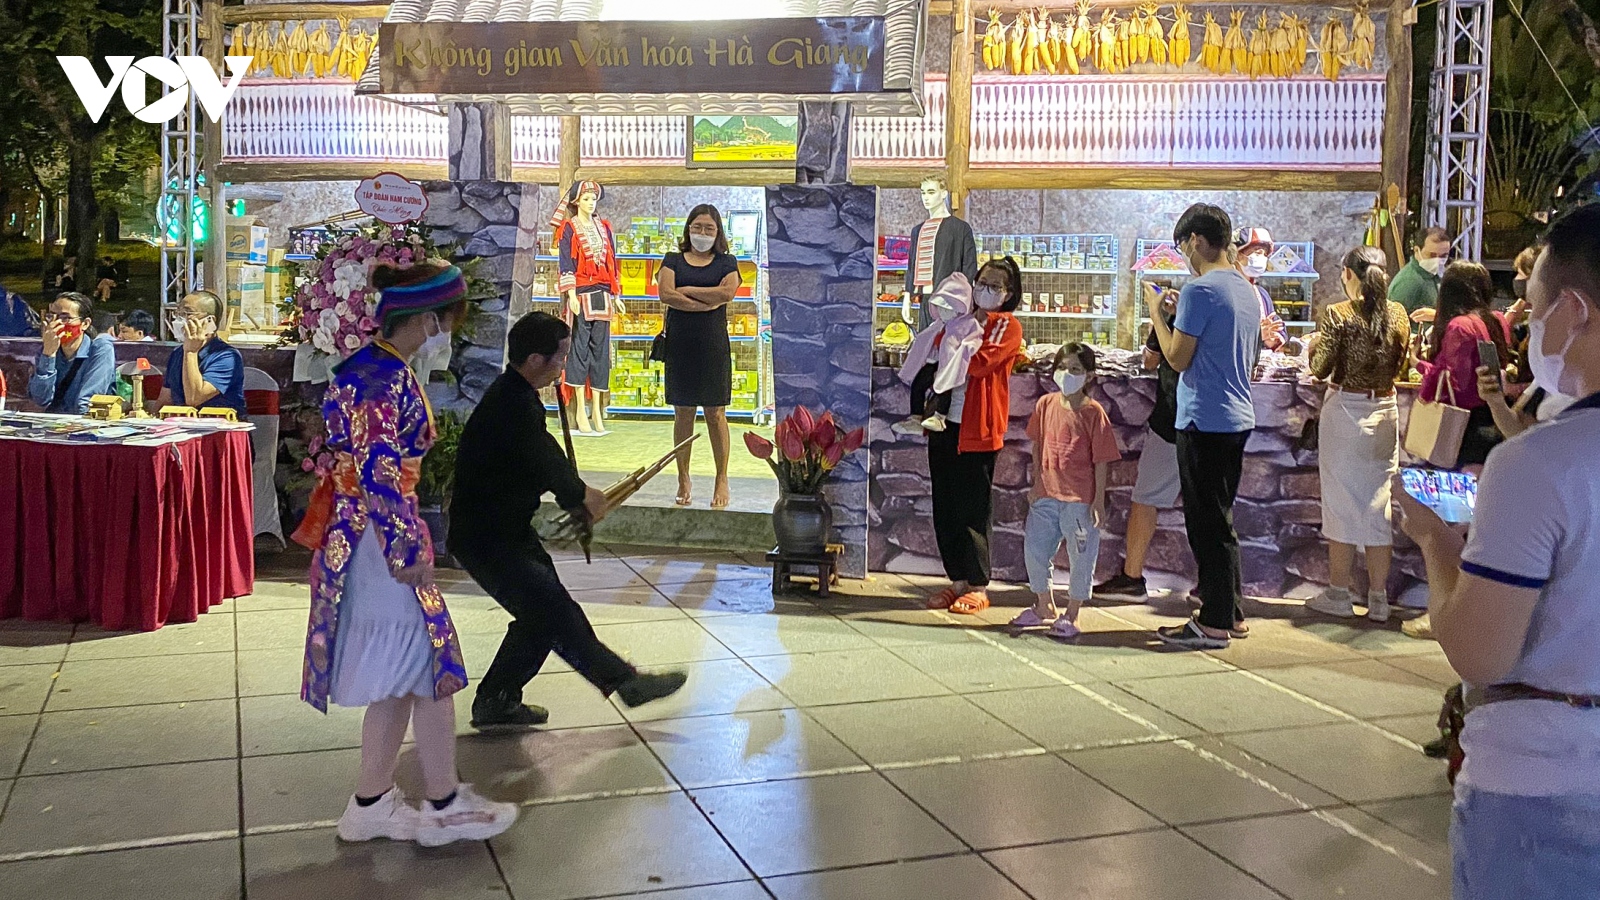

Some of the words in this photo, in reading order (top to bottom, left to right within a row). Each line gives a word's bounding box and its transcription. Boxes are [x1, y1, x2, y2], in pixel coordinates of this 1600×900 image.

[394, 39, 492, 76] Không
[504, 40, 563, 76] gian
[569, 40, 630, 68] Văn
[640, 36, 694, 67] hóa
[704, 35, 754, 67] Hà
[767, 37, 869, 73] Giang
[390, 194, 402, 203] NAM
